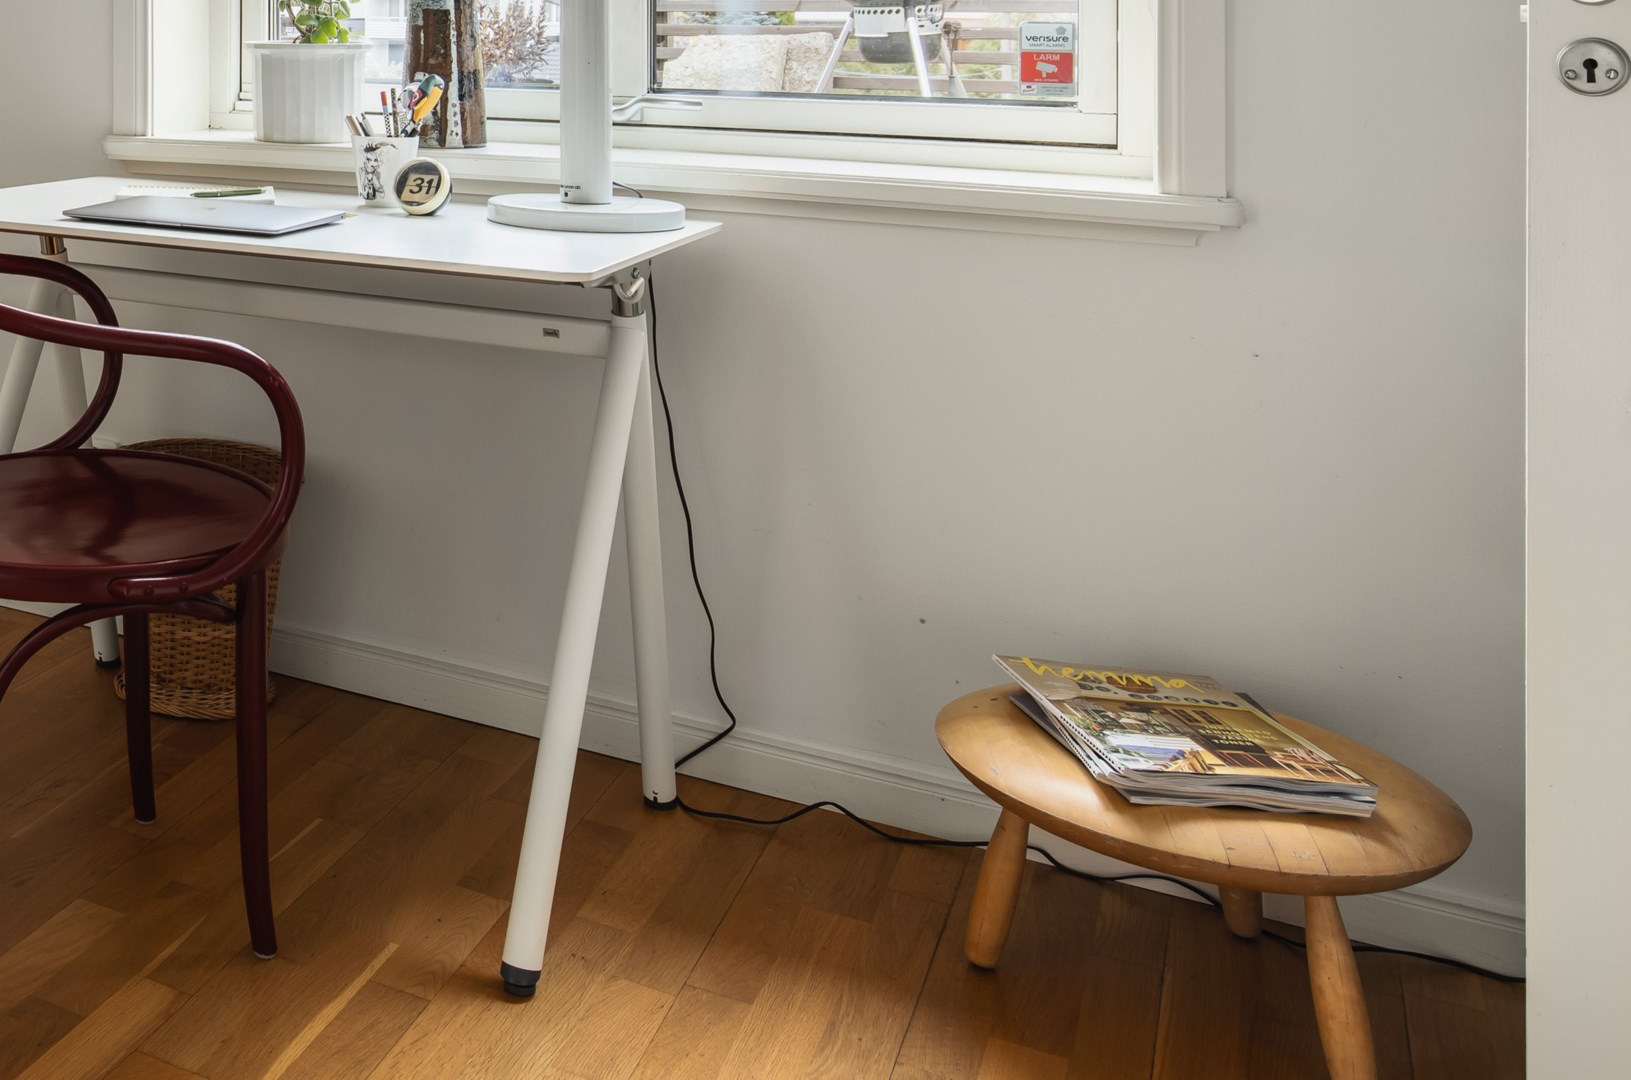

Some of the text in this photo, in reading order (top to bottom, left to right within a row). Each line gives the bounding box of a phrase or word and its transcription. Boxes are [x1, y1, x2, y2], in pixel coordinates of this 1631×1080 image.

[1026, 35, 1069, 43] verisure
[408, 177, 436, 195] 31
[1008, 657, 1206, 695] hemma
